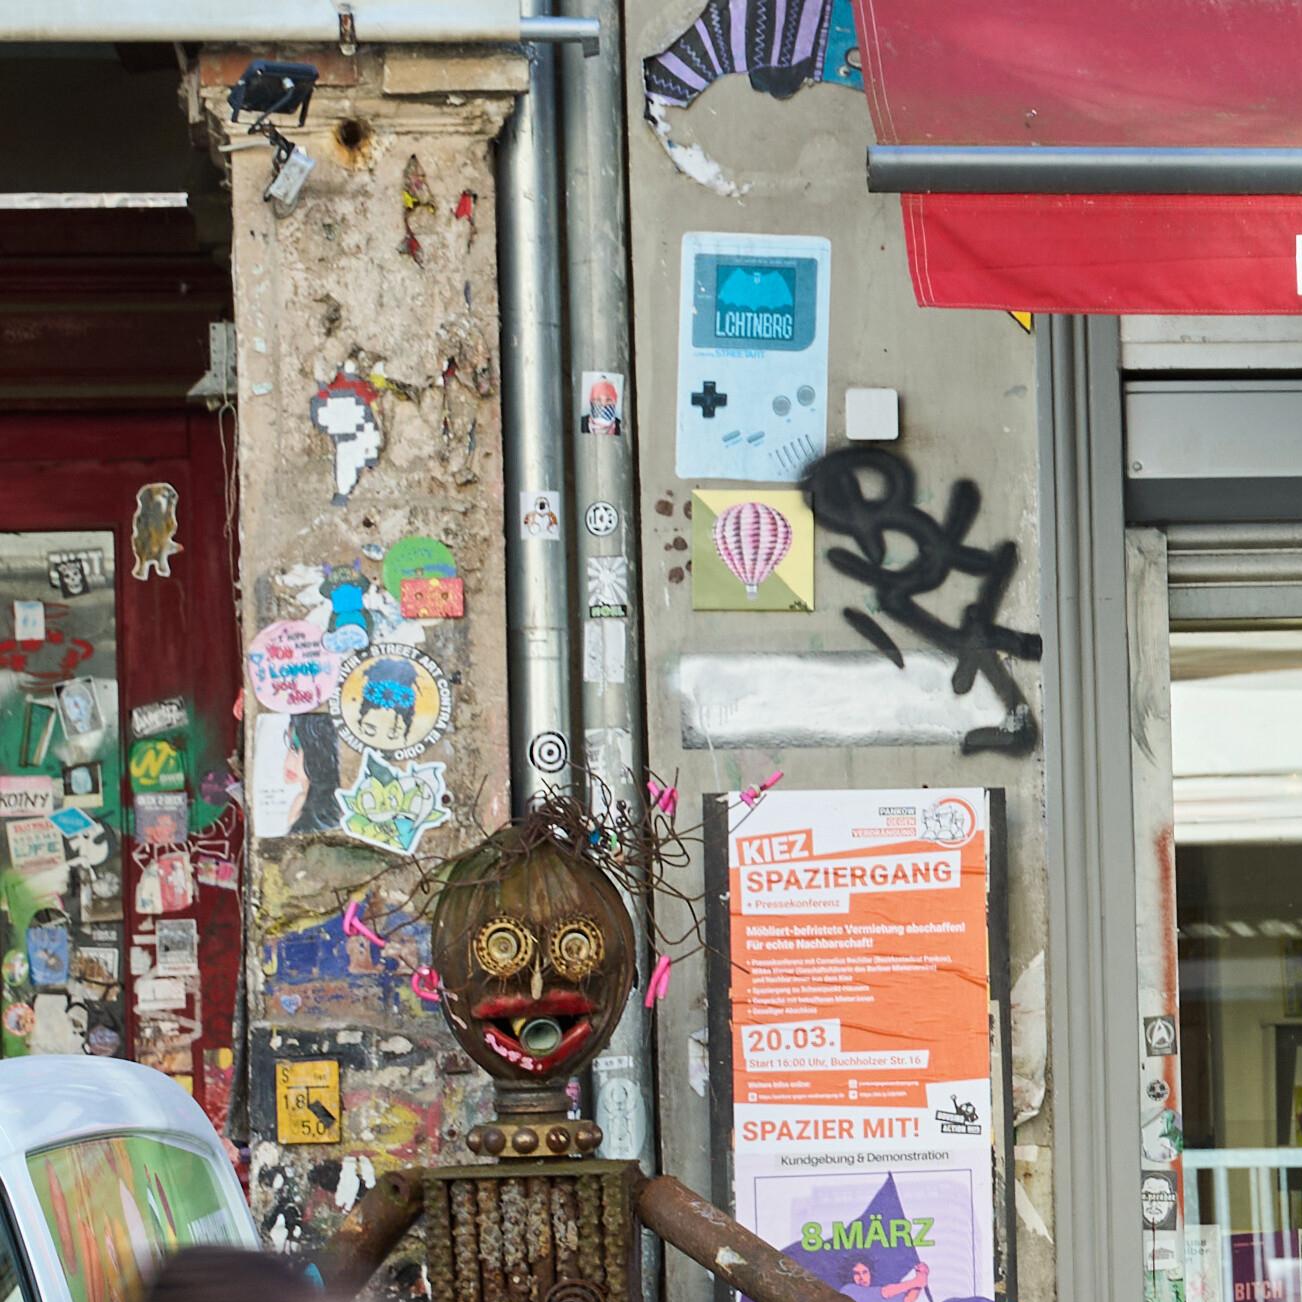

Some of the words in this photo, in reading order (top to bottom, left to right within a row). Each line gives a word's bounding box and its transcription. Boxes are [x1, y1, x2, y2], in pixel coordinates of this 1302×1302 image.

[716, 311, 793, 339] LCHTNBRG
[370, 643, 420, 659] STREET
[418, 652, 442, 673] ART
[437, 676, 452, 722] CONTRA
[742, 834, 809, 865] KIEZ
[747, 861, 952, 893] SPAZIERGANG
[755, 898, 841, 909] Pressekonferenz
[746, 924, 843, 937] Möbliert-befristete
[845, 924, 904, 937] Vermietung
[906, 922, 966, 935] abschaffen!
[746, 939, 764, 951] Für
[766, 939, 794, 951] echte
[796, 938, 873, 950] Nachbarschaft!
[748, 1026, 835, 1052] 20.03.
[749, 1058, 774, 1069] Start
[777, 1057, 805, 1068] 16:00
[808, 1057, 829, 1069] Uhr,
[831, 1055, 887, 1067] Buchholzer
[743, 1119, 854, 1142] SPAZIER
[863, 1117, 920, 1138] MIT!
[781, 1153, 854, 1166] Kundgebung
[857, 1153, 864, 1163] &
[867, 1150, 950, 1163] Demonstration
[800, 1213, 936, 1252] 8.MÄRZ
[1235, 1280, 1283, 1301] BITCH
